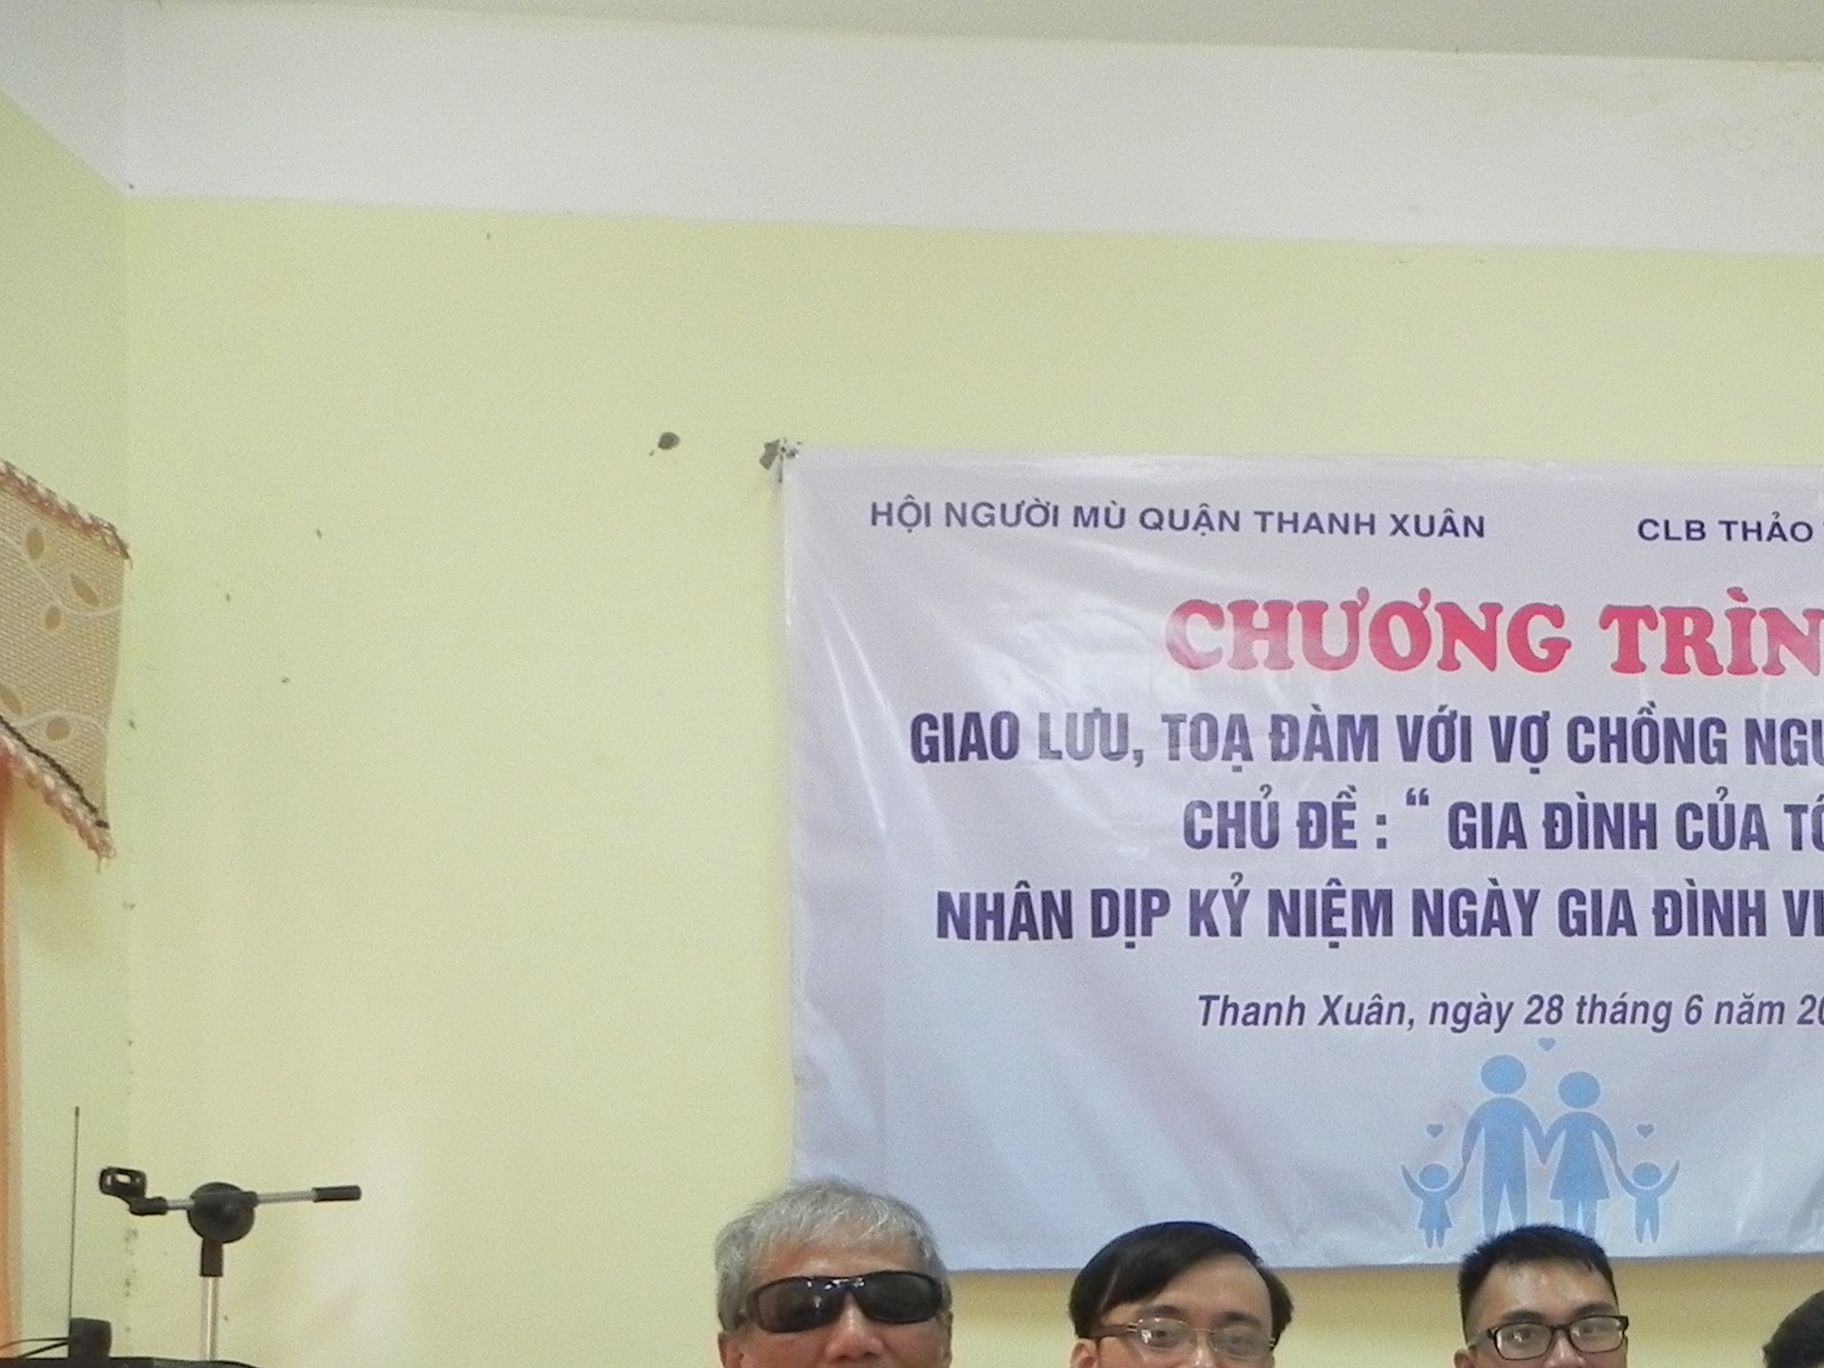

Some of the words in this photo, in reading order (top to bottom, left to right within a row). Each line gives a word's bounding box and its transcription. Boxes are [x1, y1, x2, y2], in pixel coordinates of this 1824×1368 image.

[870, 494, 932, 533] HỘI
[944, 498, 1060, 529] NGƯỜI
[1072, 500, 1127, 530] MÙ
[1138, 503, 1241, 537] QUẬN
[1253, 510, 1376, 537] THANH
[1389, 508, 1486, 539] XUÂN
[1637, 517, 1707, 542] CLB
[1718, 511, 1814, 544] THẢO
[1165, 586, 1573, 674] CHƯƠNG
[910, 710, 1020, 764] GIAO
[1038, 707, 1145, 768] LƯU,
[1268, 703, 1380, 763] ĐÀM
[1395, 704, 1473, 764] VỚI
[1489, 709, 1551, 775] VỢ
[1566, 700, 1729, 766] CHỒNG
[1183, 784, 1281, 850] CHỦ
[1296, 784, 1359, 850] ĐỀ
[1447, 801, 1529, 850] GIA
[1542, 791, 1658, 851] ĐÌNH
[1674, 786, 1771, 852] CỦA
[937, 880, 1074, 941] NHÂN
[1089, 888, 1172, 949] DỊP
[1188, 871, 1252, 938] KỶ
[1267, 877, 1394, 949] NIỆM
[1411, 877, 1542, 938] NGÀY
[1558, 887, 1639, 938] GIA
[1652, 878, 1768, 938] ĐÌNH
[1198, 993, 1307, 1028] Thanh
[1317, 992, 1416, 1031] Xuân,
[1429, 991, 1515, 1034] ngày
[1523, 993, 1565, 1027] 28
[1575, 992, 1674, 1035] tháng
[1684, 993, 1705, 1026] 6
[1713, 992, 1786, 1027] năm
